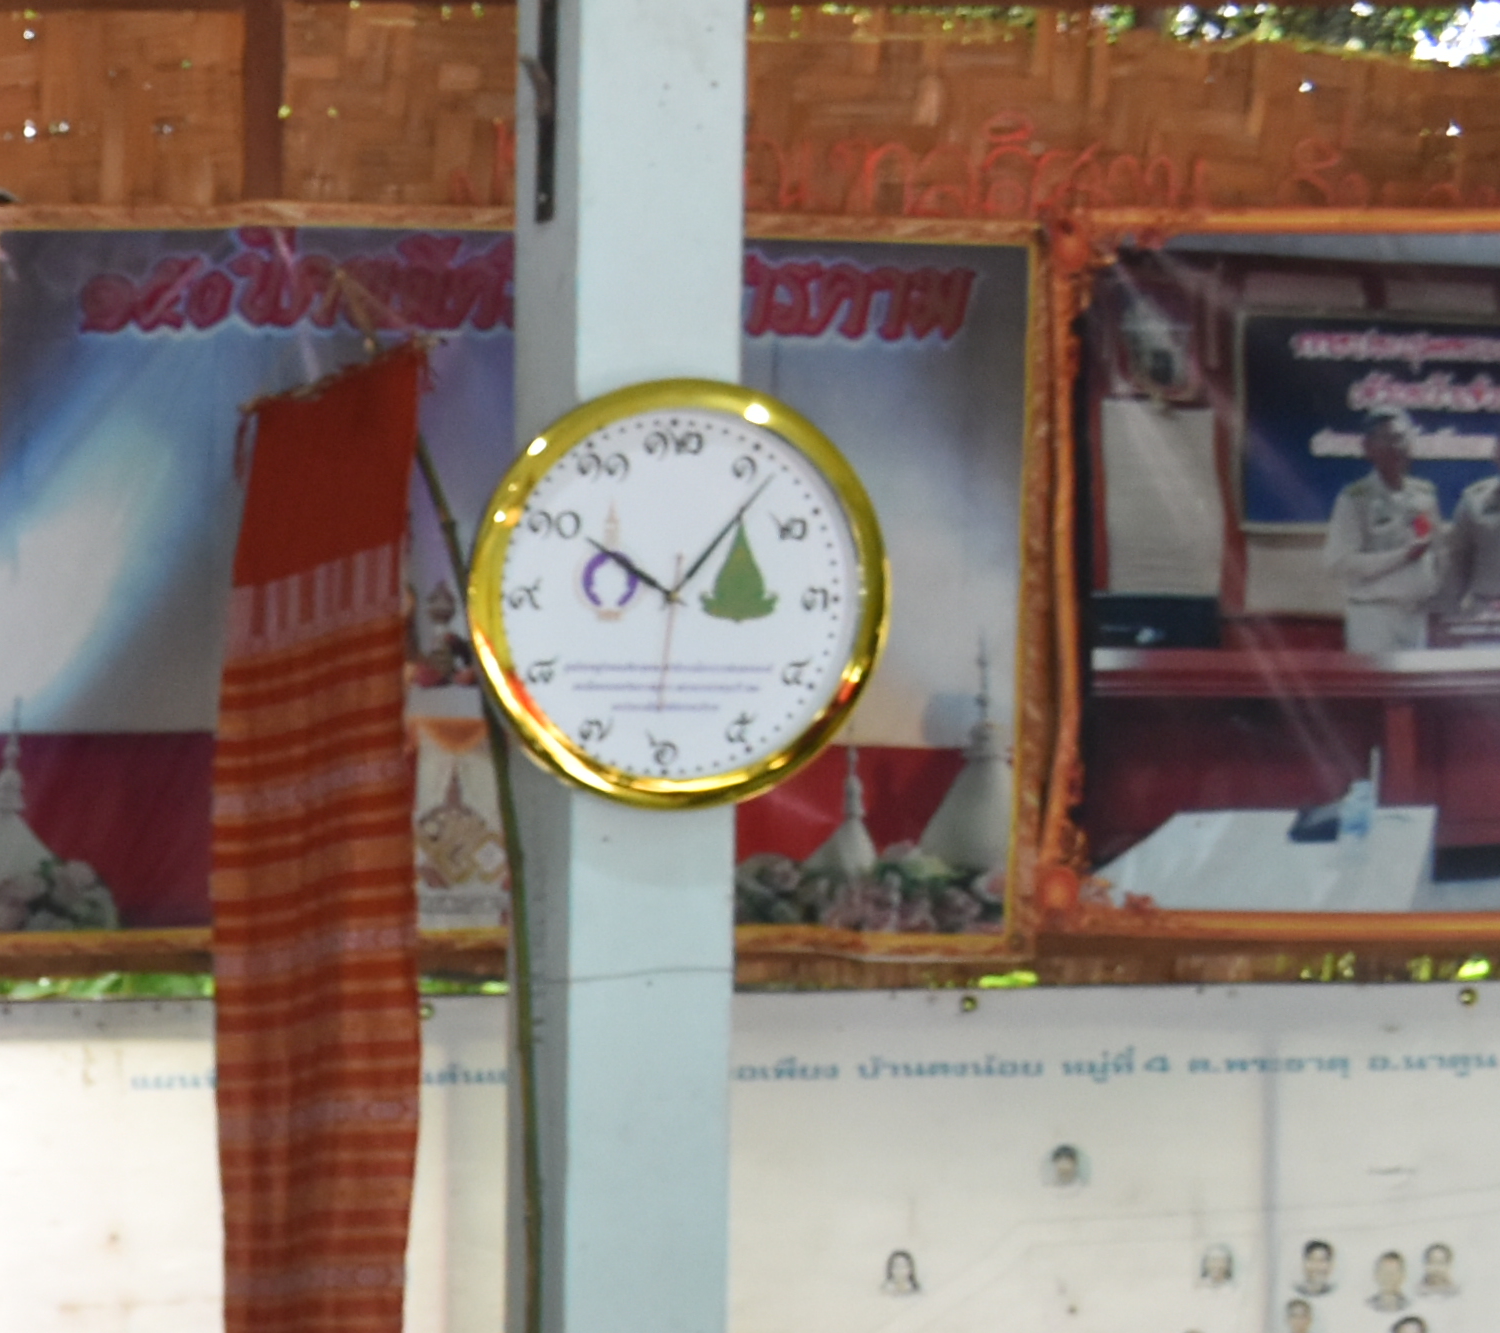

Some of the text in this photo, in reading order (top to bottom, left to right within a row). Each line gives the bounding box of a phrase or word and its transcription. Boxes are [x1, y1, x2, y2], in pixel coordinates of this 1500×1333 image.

[643, 431, 704, 460] ๑๒
[577, 451, 630, 479] ๑๑
[528, 510, 581, 538] ๑๐
